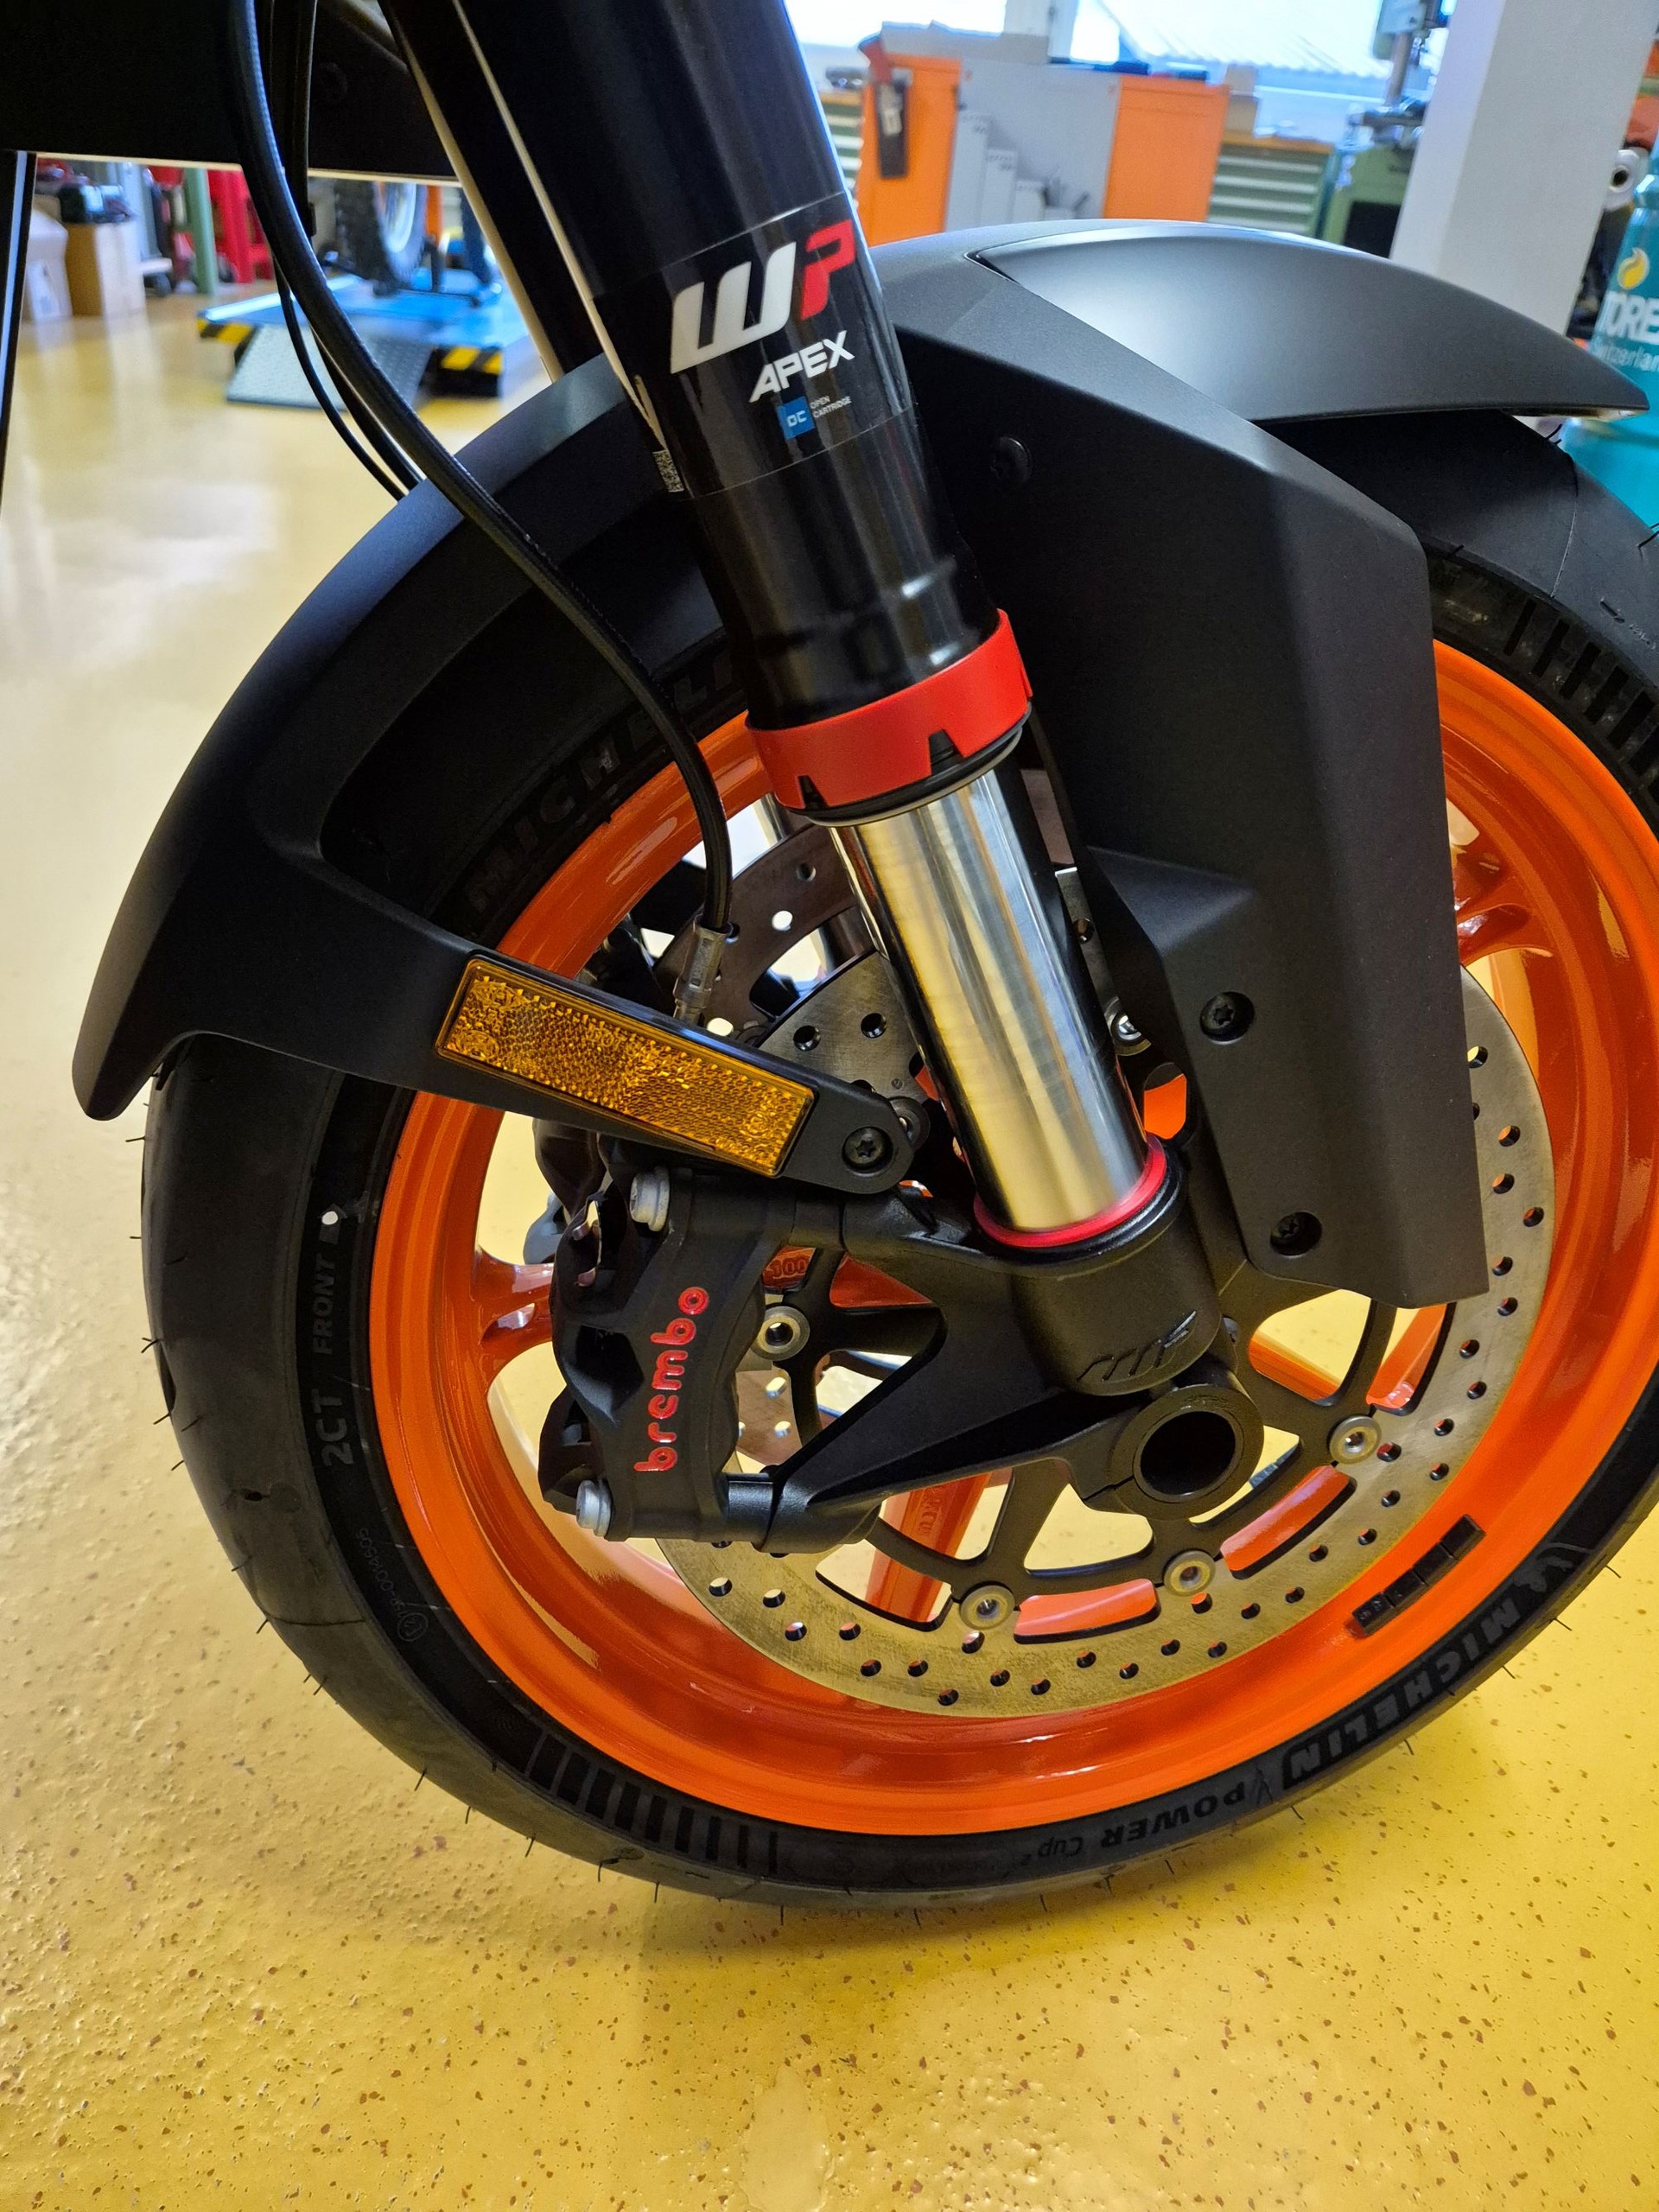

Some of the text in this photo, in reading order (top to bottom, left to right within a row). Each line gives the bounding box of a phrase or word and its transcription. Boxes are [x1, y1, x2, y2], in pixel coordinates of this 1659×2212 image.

[671, 219, 855, 374] WP
[748, 330, 855, 403] APEX
[810, 396, 830, 410] OPEN
[786, 410, 807, 428] OC
[813, 396, 852, 418] CARTRIDGE
[311, 1253, 354, 1466] 2CT FRONT
[633, 1286, 710, 1472] brembo
[1290, 1600, 1521, 1779] MICHELIN
[1100, 1781, 1245, 1849] POWER
